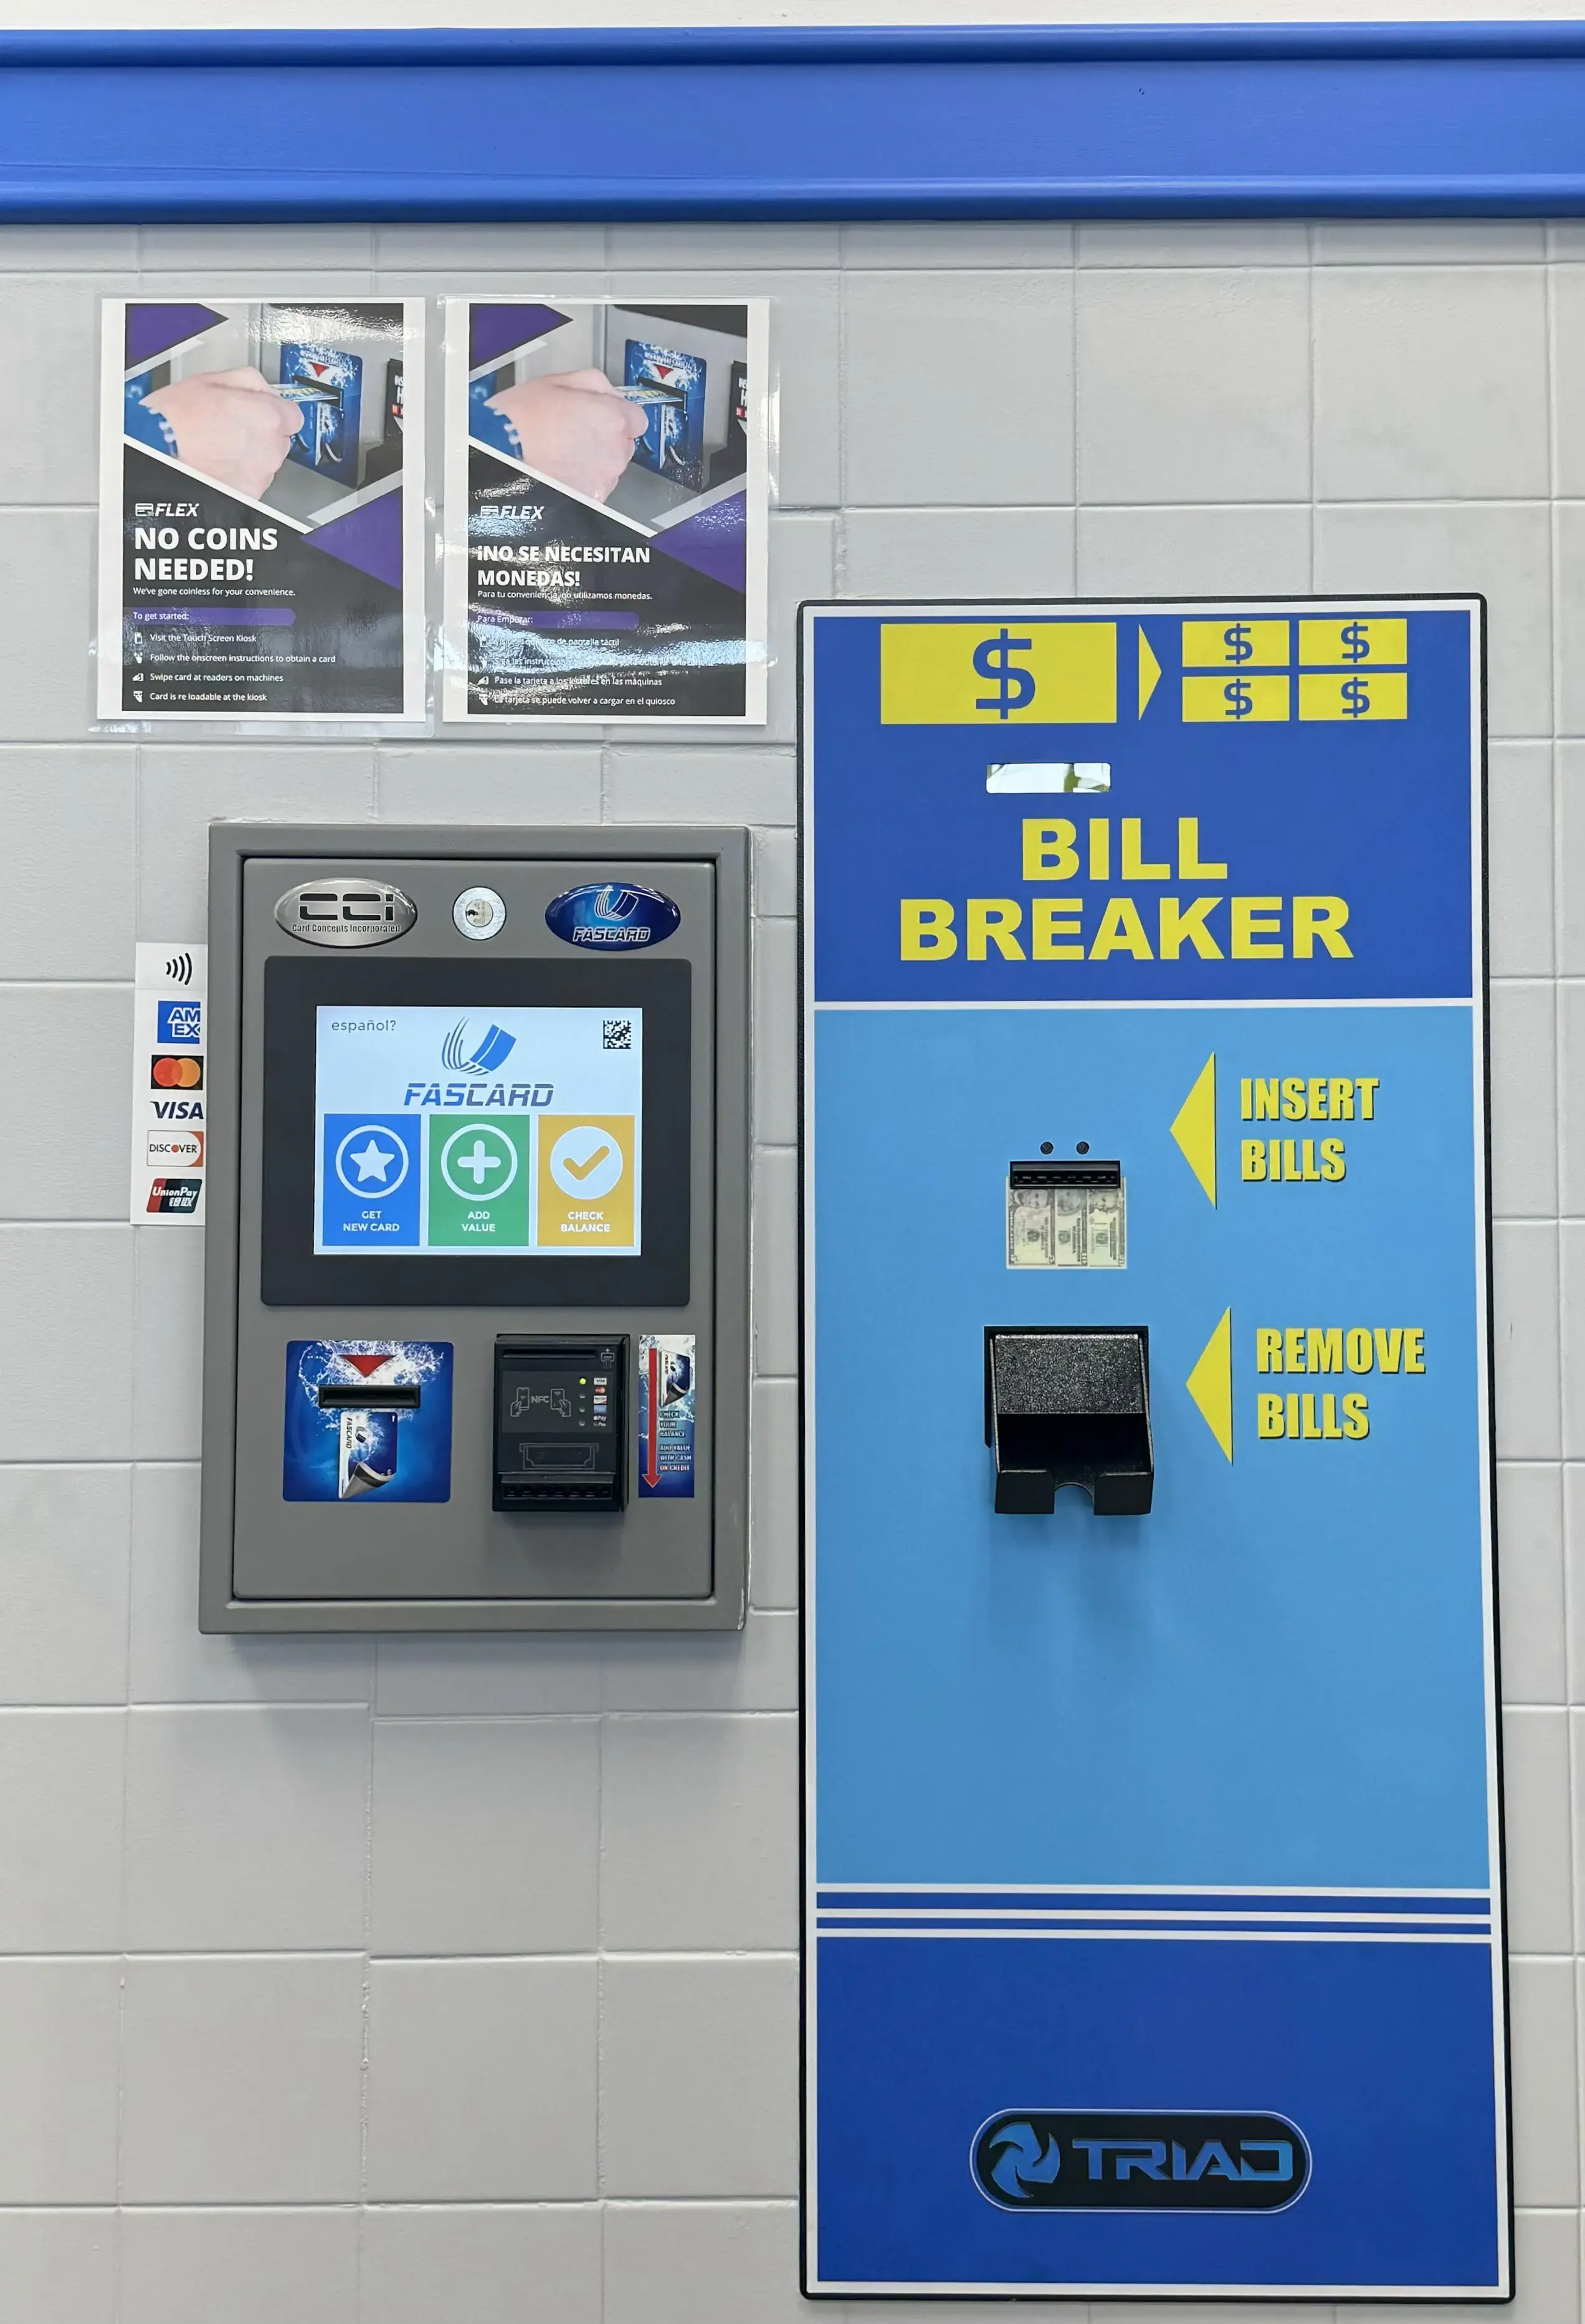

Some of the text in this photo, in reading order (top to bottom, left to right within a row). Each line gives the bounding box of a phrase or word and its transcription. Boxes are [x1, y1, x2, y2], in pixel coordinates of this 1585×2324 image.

[156, 503, 199, 517] FLEX
[499, 505, 545, 520] FLEX
[135, 528, 278, 550] NO COINS
[518, 546, 540, 561] SE
[545, 546, 650, 563] NECESITAN
[135, 558, 254, 581] NEEDED!
[478, 569, 580, 586] MONEDAS!
[245, 588, 295, 596] convenience.
[573, 591, 612, 599] utilizamos
[614, 592, 652, 600] monedas.
[145, 612, 158, 621] get
[1223, 621, 1370, 664] $ $
[285, 655, 310, 663] obtain
[318, 655, 336, 663] card
[150, 674, 173, 682] Swipe
[203, 674, 232, 682] readers
[973, 628, 1035, 719] $
[495, 676, 512, 684] Pase
[523, 677, 548, 686] tarjeta
[625, 678, 662, 687] máquinas
[188, 693, 221, 701] loadable
[232, 693, 245, 701] the
[247, 693, 267, 701] kiosk
[505, 696, 530, 705] tarjeta
[542, 697, 566, 705] puede
[645, 698, 675, 707] quiosco
[1223, 676, 1370, 719] $ $
[1022, 817, 1228, 880] BILL
[292, 924, 400, 933] Card Concepts Incorporated
[573, 926, 650, 942] FASCARD
[900, 896, 1354, 961] BREAKER
[170, 1009, 201, 1022] AM
[174, 1024, 200, 1036] EX
[331, 1020, 396, 1033] español?
[403, 1083, 554, 1107] FASCARD
[1240, 1078, 1379, 1120] INSERT
[150, 1101, 204, 1120] VISA
[150, 1144, 198, 1153] DISCOVER
[1241, 1139, 1346, 1182] BILLS
[152, 1186, 198, 1201] UnionPay
[361, 1211, 382, 1219] GET
[467, 1211, 490, 1219] ADD
[568, 1211, 604, 1220] CHECK
[343, 1223, 399, 1232] NEW CARD
[462, 1223, 496, 1232] VALUE
[560, 1224, 611, 1232] BALANCE
[1256, 1328, 1426, 1374] REMOVE
[1257, 1393, 1371, 1440] BILLS
[1072, 2139, 1293, 2181] TRIAD
